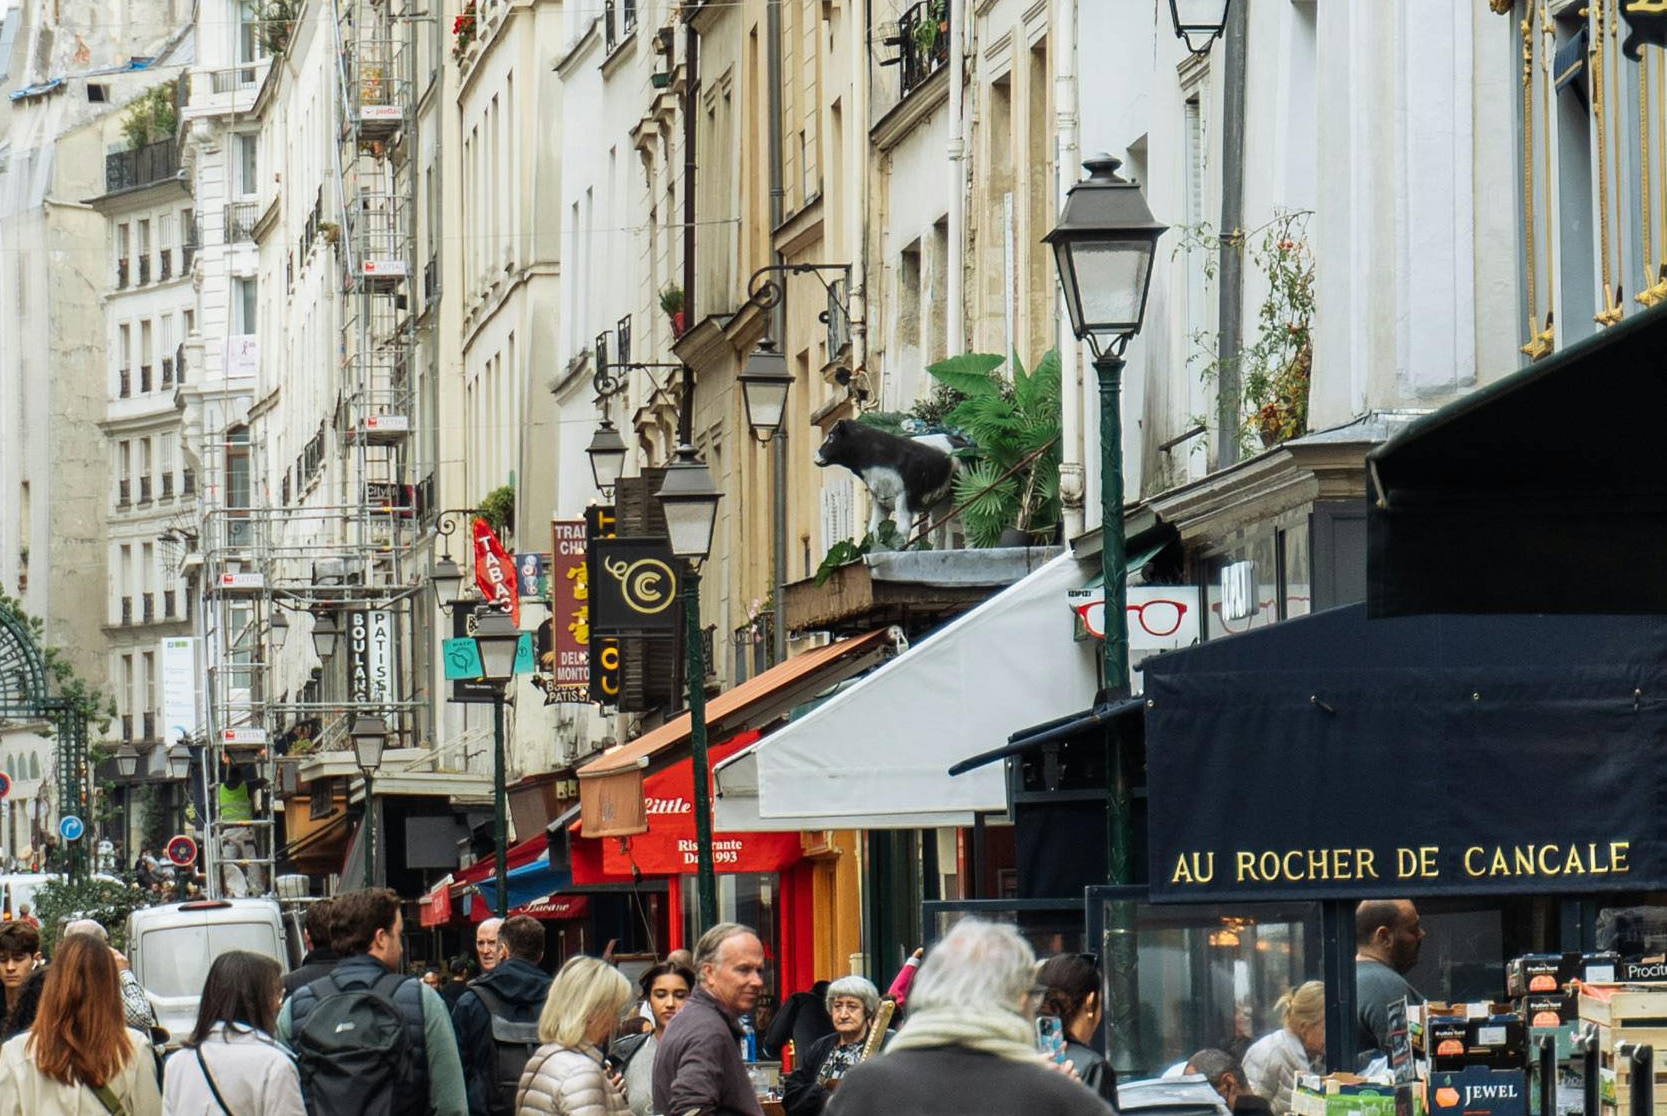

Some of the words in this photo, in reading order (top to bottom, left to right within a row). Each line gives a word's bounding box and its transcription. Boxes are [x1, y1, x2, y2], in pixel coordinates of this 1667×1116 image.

[555, 526, 587, 539] TRAI
[560, 541, 587, 556] CHI
[557, 667, 590, 681] MONTO
[678, 838, 742, 851] Risrante
[684, 851, 699, 864] Da
[1171, 851, 1215, 883] AU
[1236, 848, 1379, 881] ROCHER
[1397, 846, 1440, 879] DE
[1464, 841, 1630, 877] CANCALE
[1628, 963, 1667, 979] Procit
[1465, 1084, 1518, 1106] JEWEL
